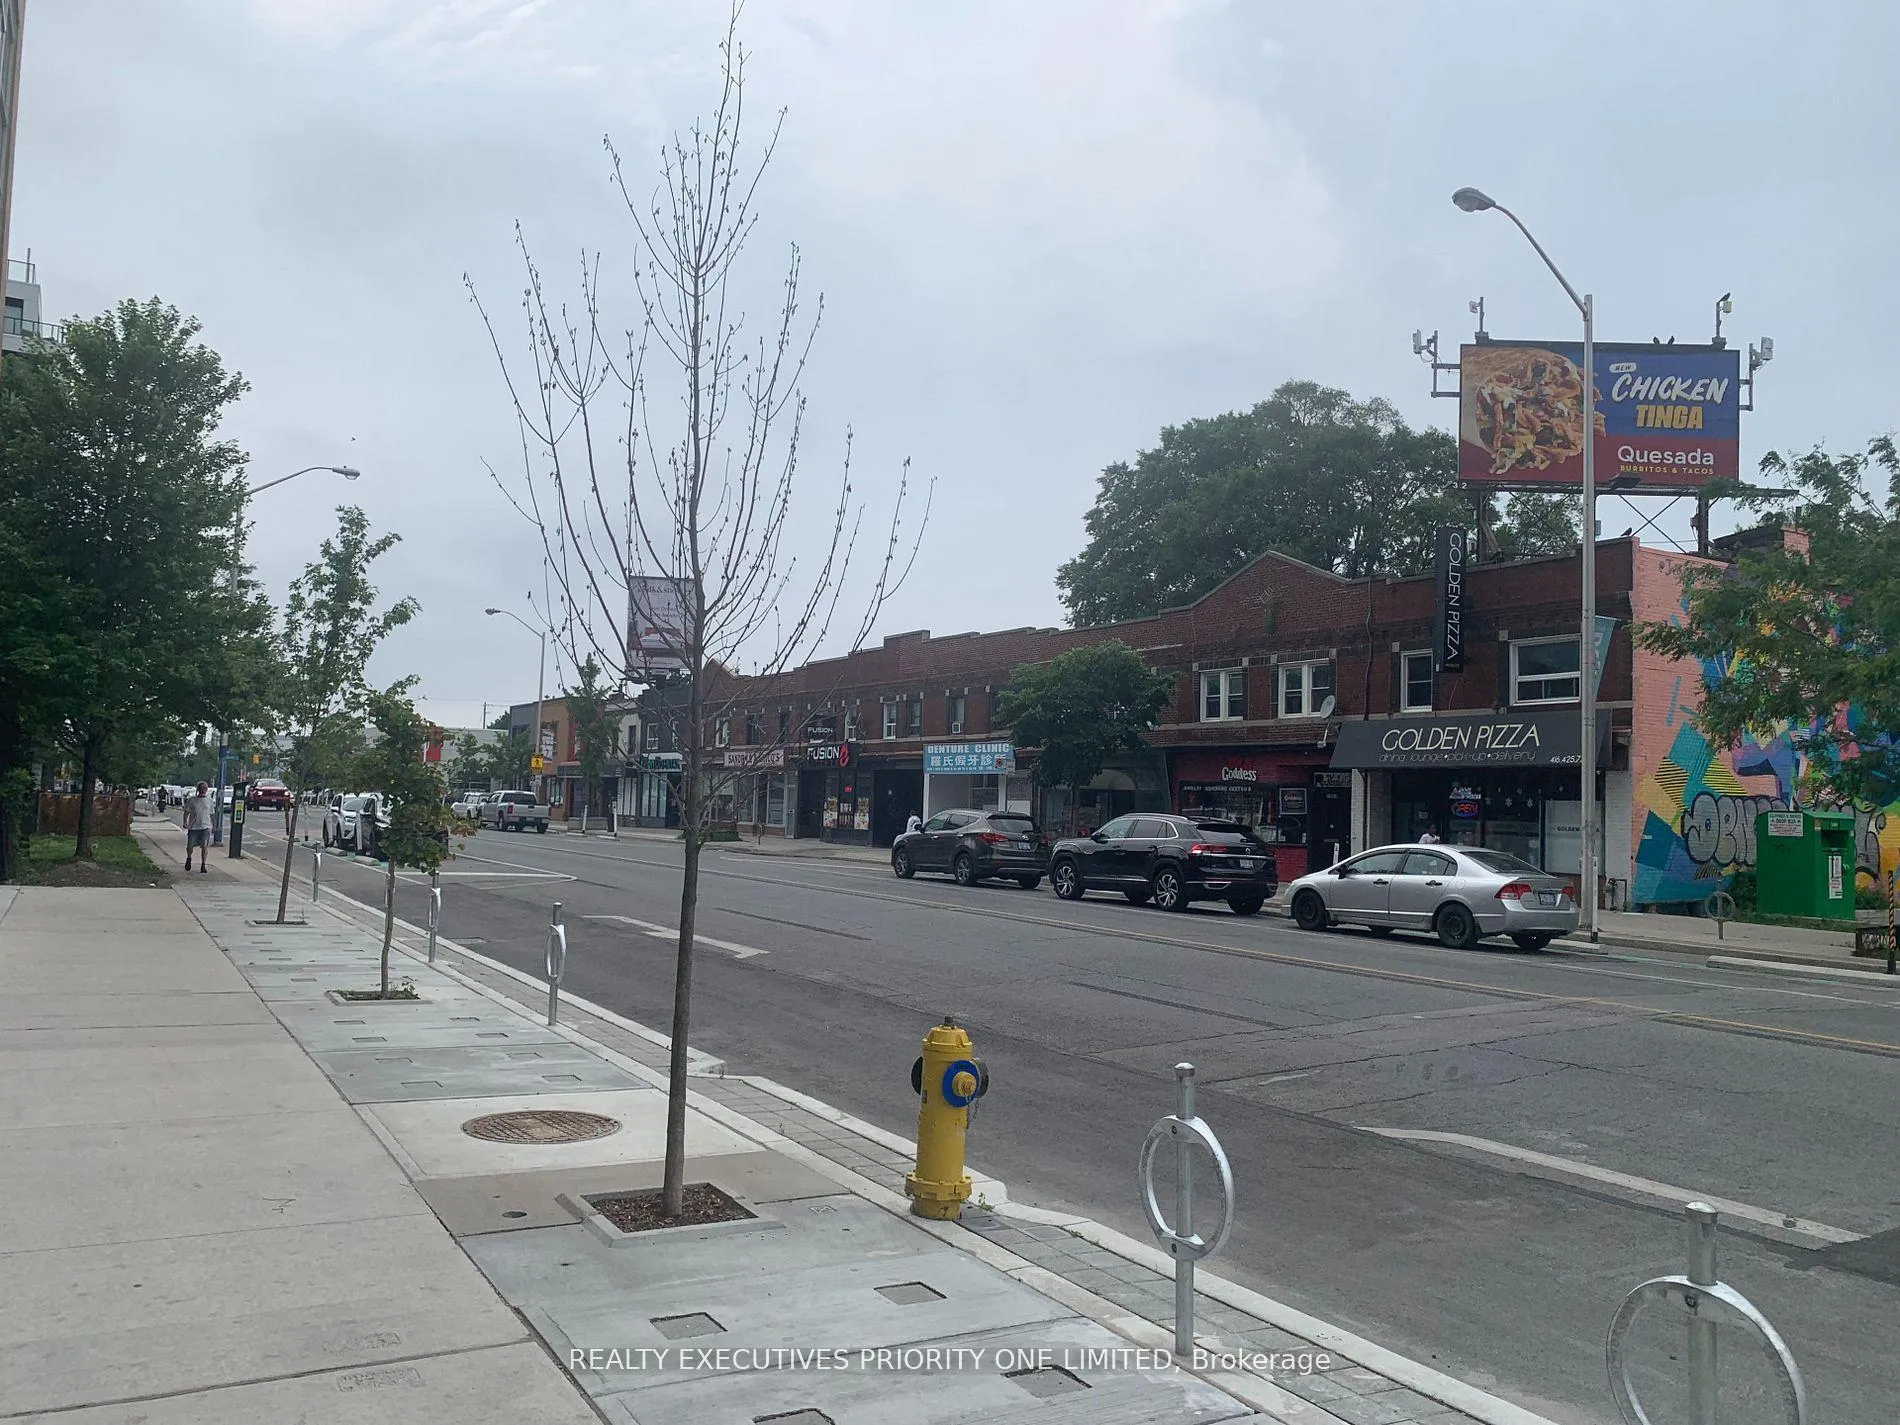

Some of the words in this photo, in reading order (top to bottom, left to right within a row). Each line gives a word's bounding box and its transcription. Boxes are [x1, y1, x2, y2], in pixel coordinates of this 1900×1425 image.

[1611, 373, 1729, 404] CHICKEN
[1636, 404, 1703, 430] TINGA
[1617, 445, 1714, 465] Quesada
[1620, 465, 1668, 473] BURRITOS
[1682, 467, 1714, 475] TACOS
[1448, 533, 1462, 607] GOLDEN
[1447, 610, 1460, 660] PIZZA
[1382, 725, 1472, 751] GOLDEN
[1474, 724, 1540, 749] PIZZA
[807, 746, 840, 760] FUSION
[928, 744, 970, 754] DENTURE
[975, 743, 1010, 753] CLINIC
[1490, 750, 1536, 762] delivery
[1222, 766, 1257, 781] Goddess
